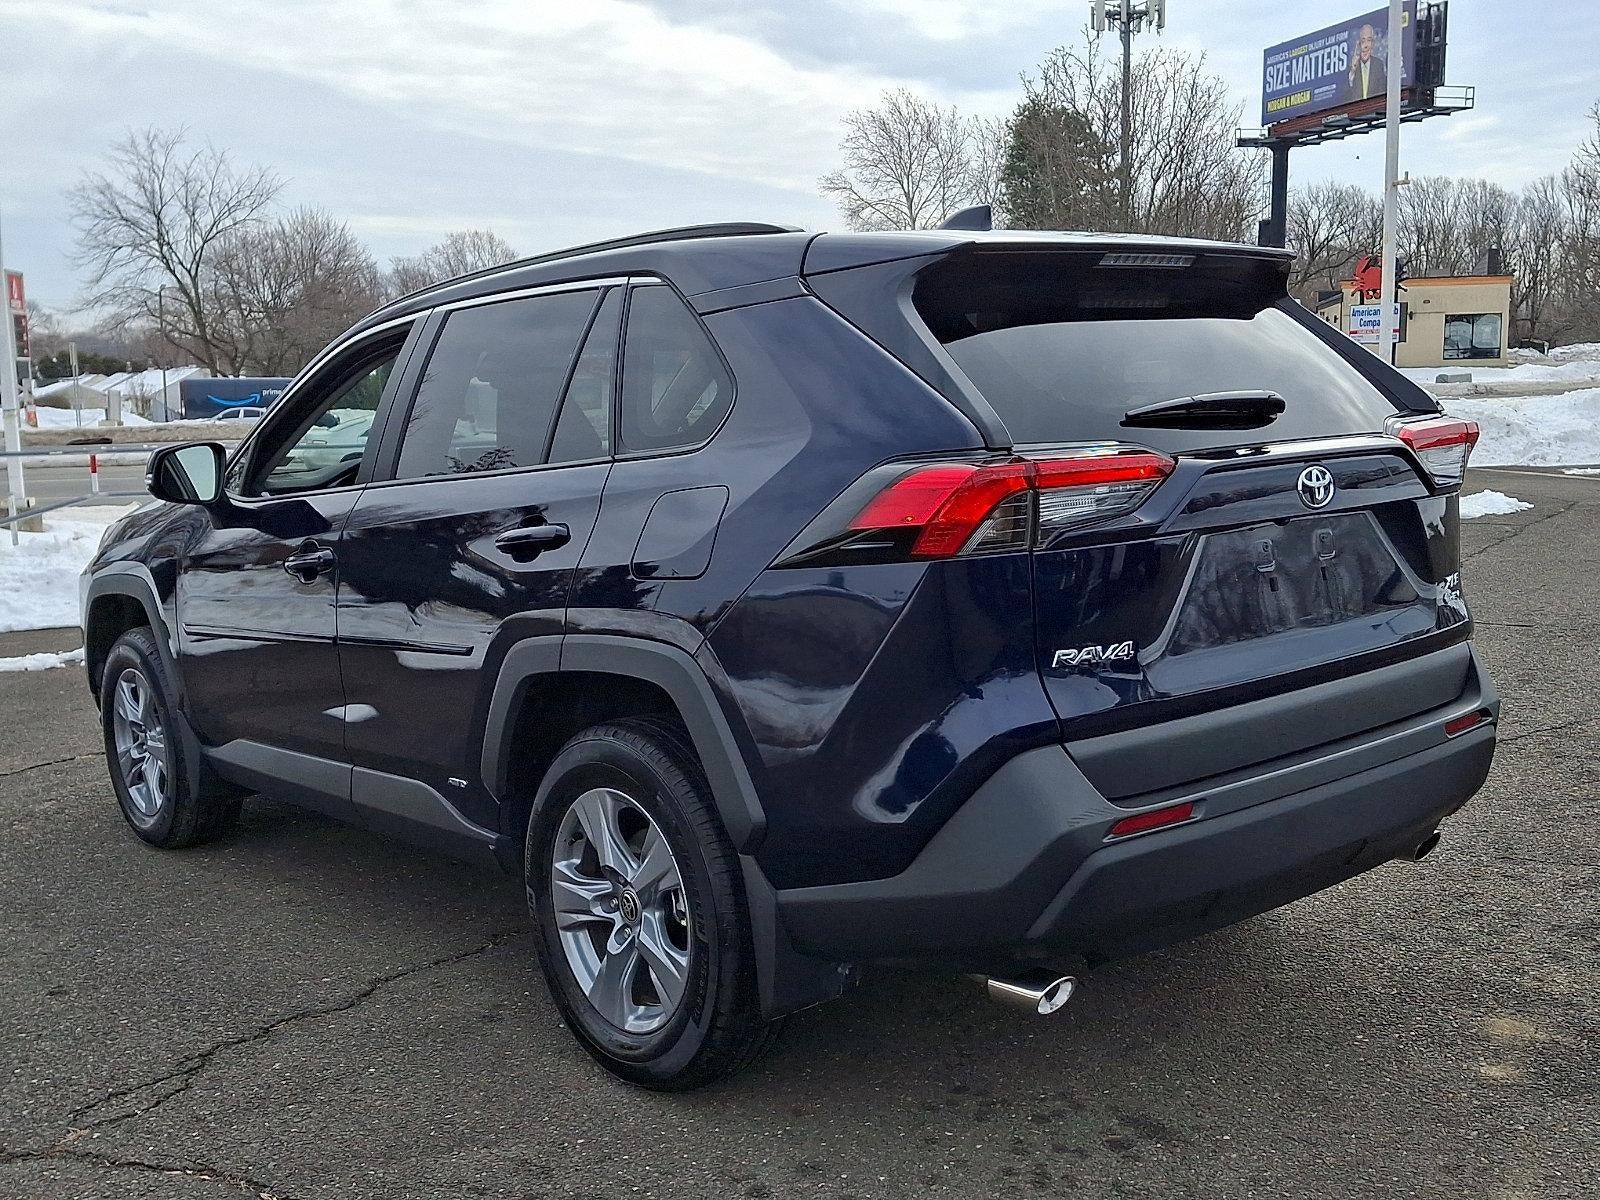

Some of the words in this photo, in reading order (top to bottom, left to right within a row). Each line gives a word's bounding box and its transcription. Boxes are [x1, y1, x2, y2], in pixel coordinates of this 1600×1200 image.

[1266, 51, 1289, 65] AMERICA'S
[1289, 44, 1308, 58] LARGEST
[1266, 60, 1290, 93] SIZE
[1291, 41, 1348, 86] MATTERS
[1267, 97, 1286, 113] MORGAN
[1291, 89, 1311, 106] MORGAN
[1351, 307, 1381, 317] American
[1359, 317, 1381, 329] Compa
[1051, 640, 1135, 668] RAV4
